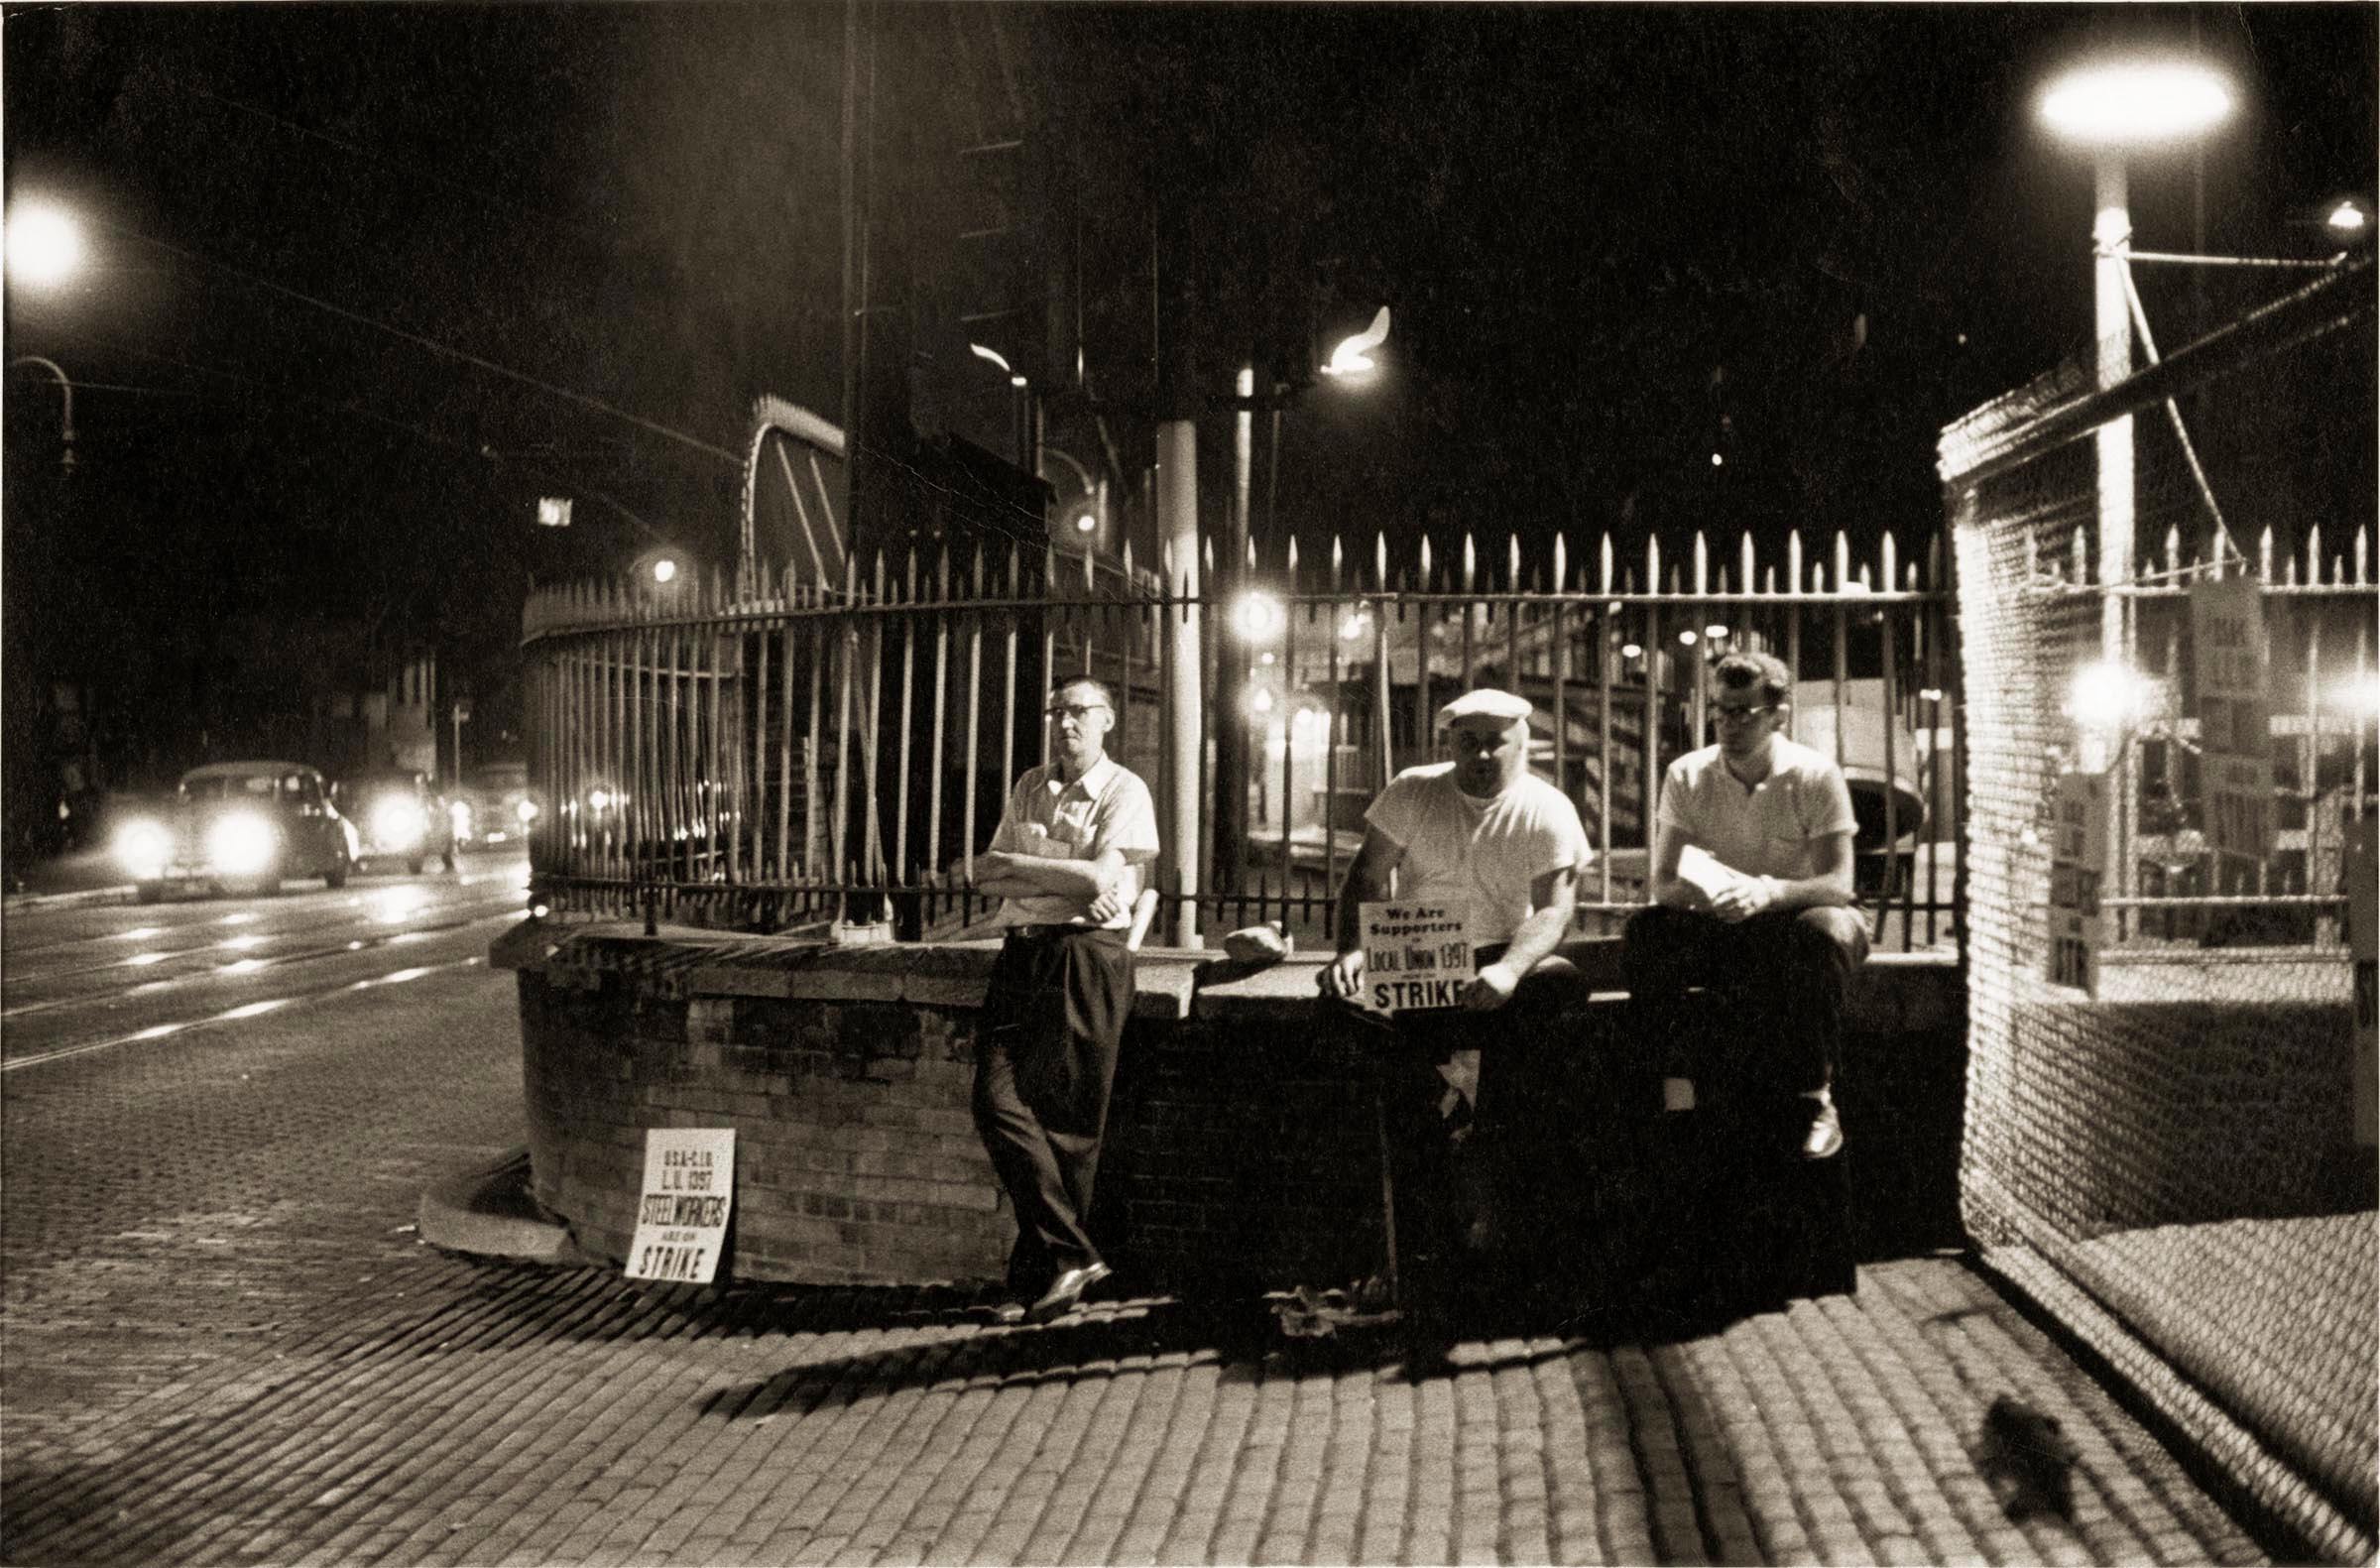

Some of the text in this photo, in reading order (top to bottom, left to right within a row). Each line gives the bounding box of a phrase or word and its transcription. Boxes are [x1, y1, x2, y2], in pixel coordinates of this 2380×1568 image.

[1386, 906, 1445, 920] We Are
[1370, 922, 1463, 936] Supporters
[1440, 941, 1468, 969] 1397
[688, 1169, 713, 1191] 1397
[642, 1194, 727, 1228] STEEL WORKERS
[639, 1246, 705, 1279] STRIKE
